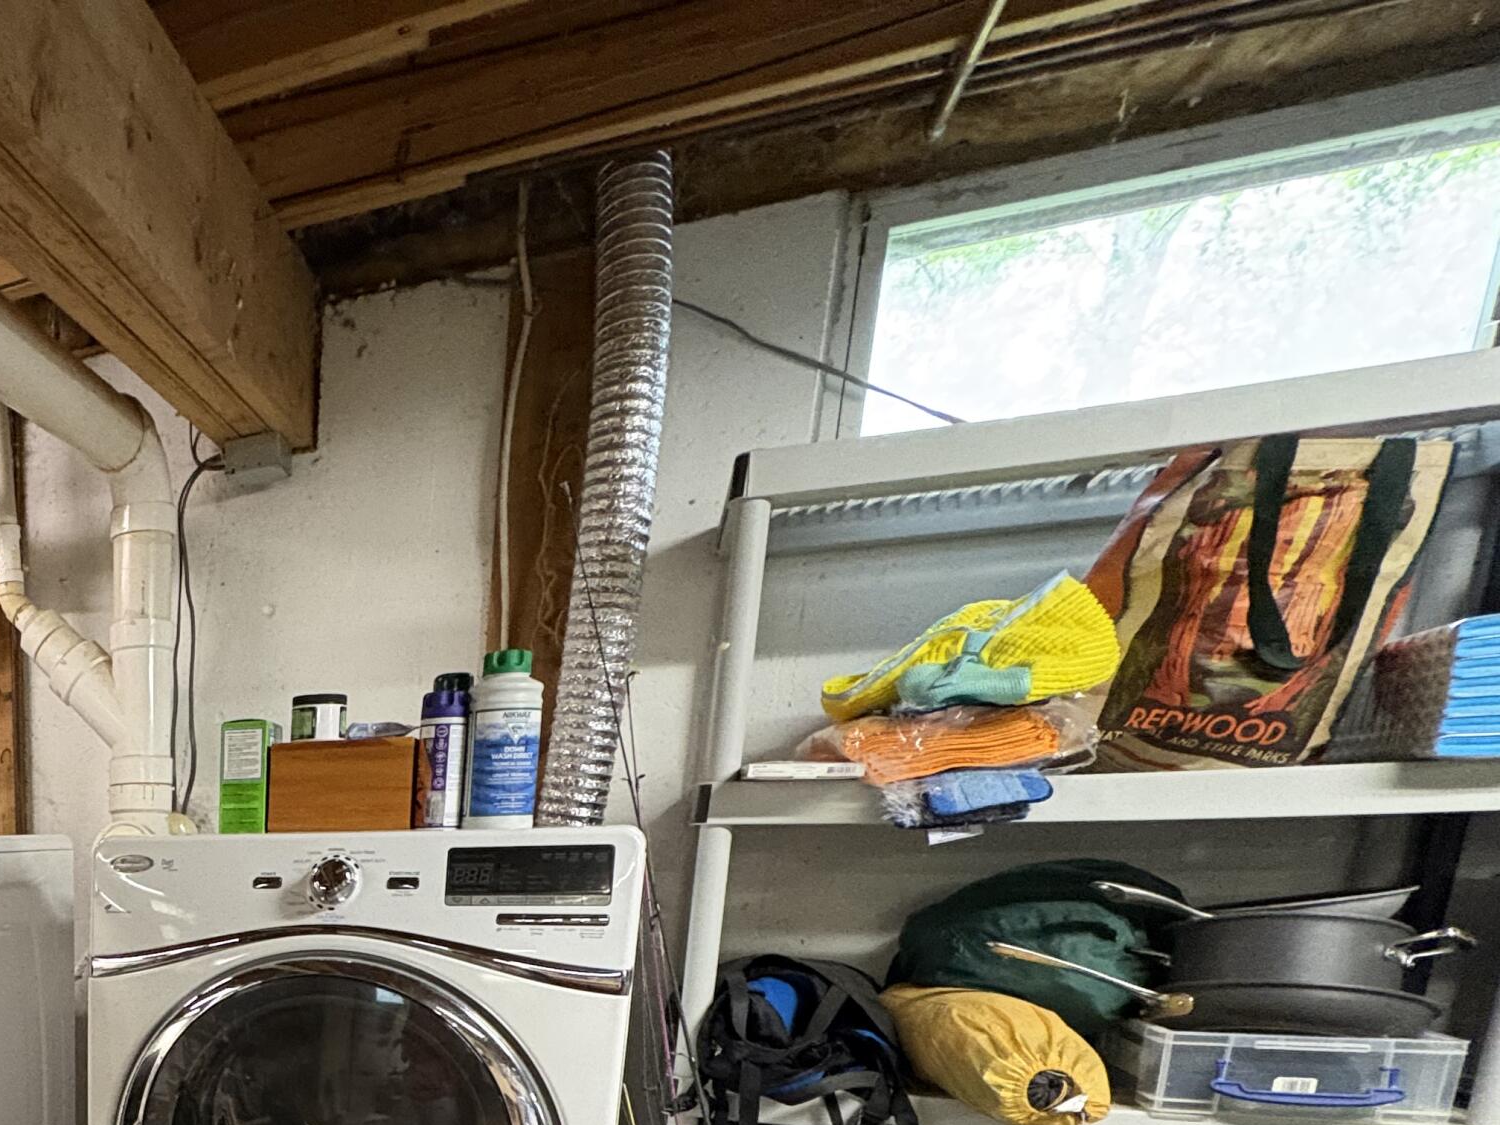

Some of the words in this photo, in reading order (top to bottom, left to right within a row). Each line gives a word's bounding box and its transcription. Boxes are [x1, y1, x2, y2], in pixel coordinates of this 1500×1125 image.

[1168, 737, 1199, 748] AND
[1204, 741, 1242, 756] STATE
[1247, 749, 1292, 764] PARKS
